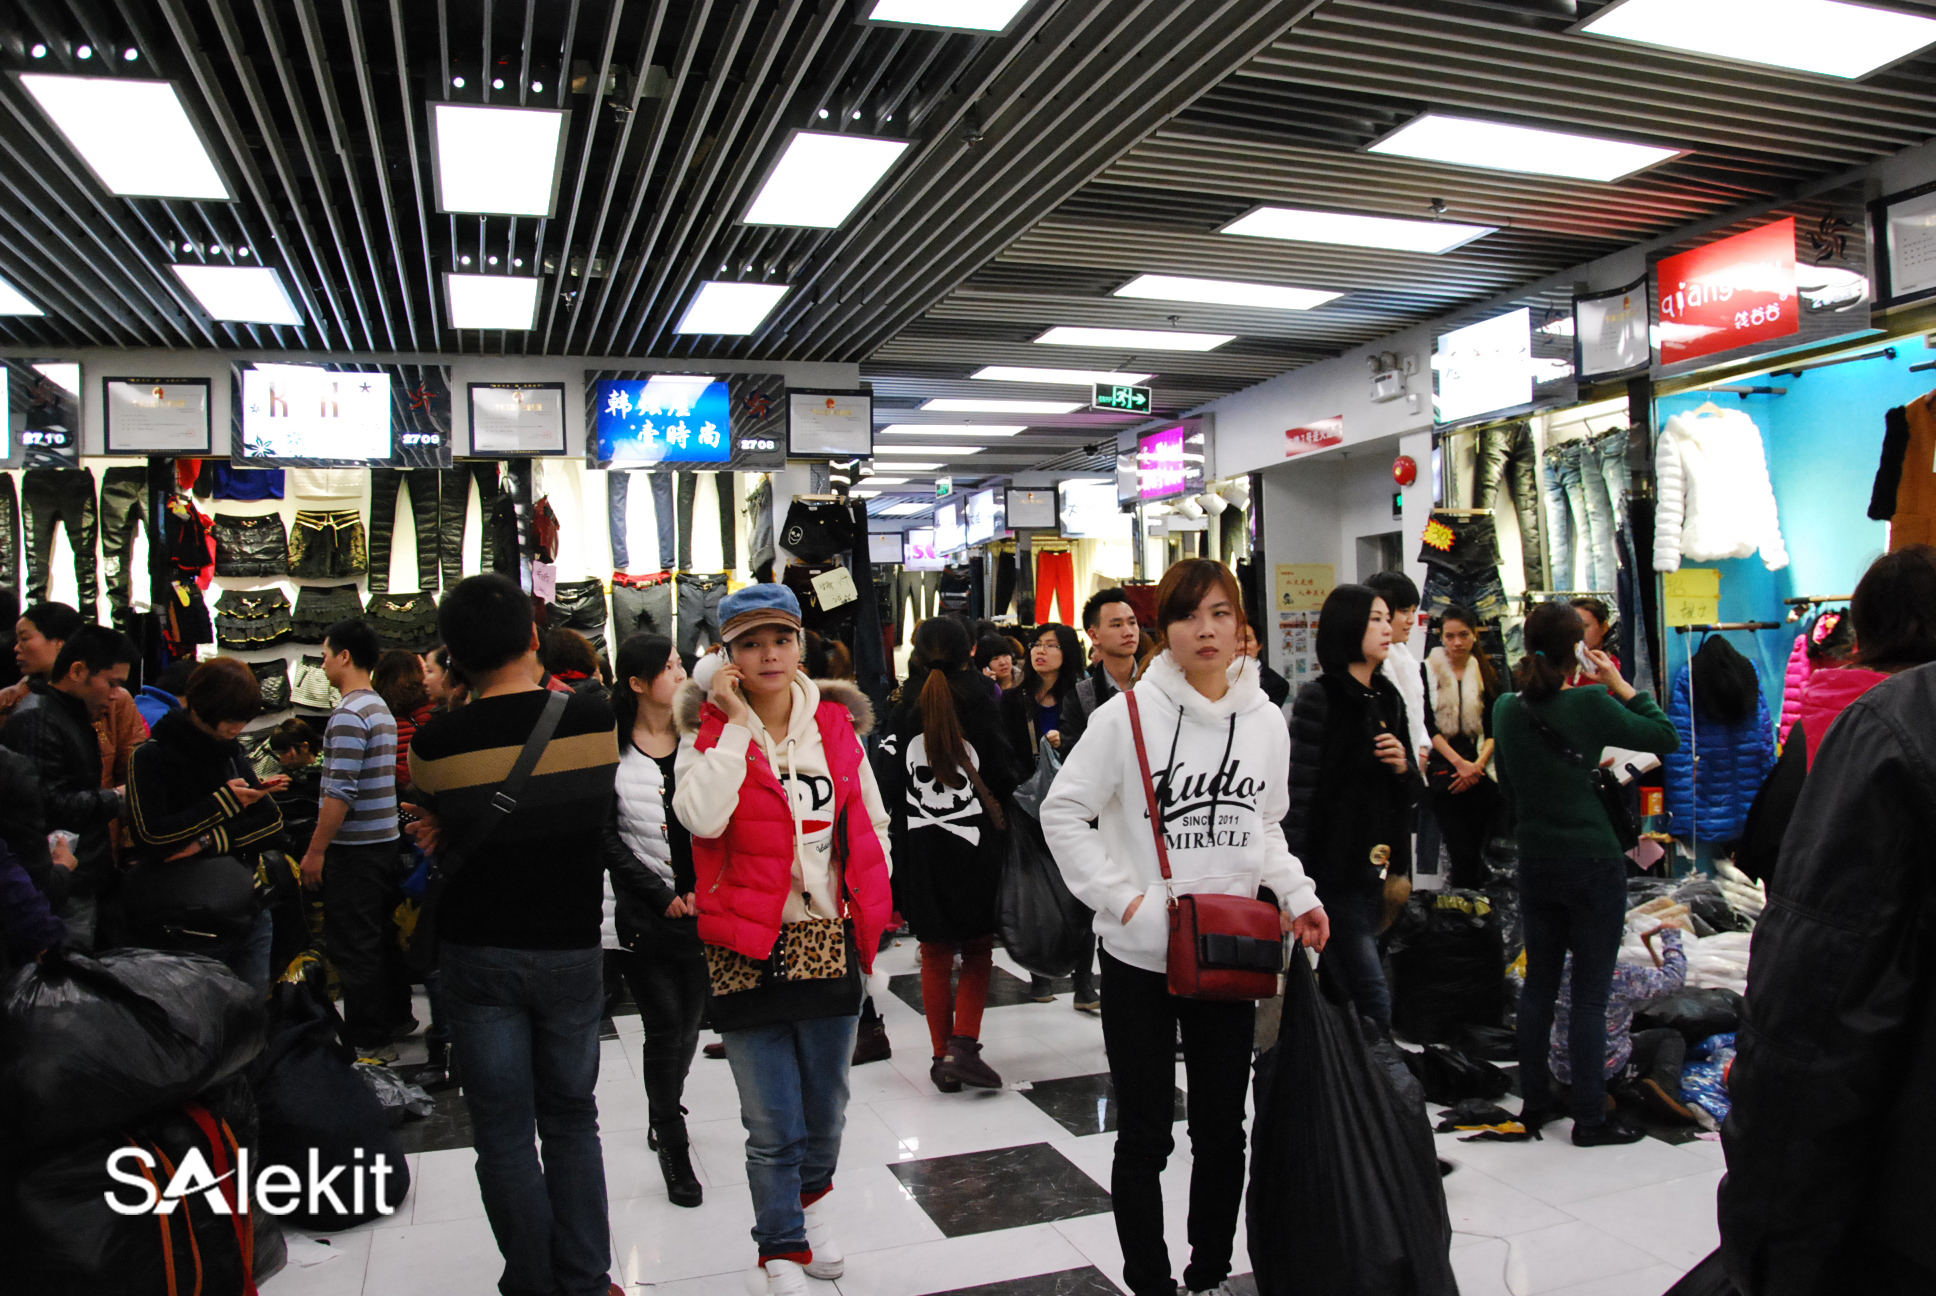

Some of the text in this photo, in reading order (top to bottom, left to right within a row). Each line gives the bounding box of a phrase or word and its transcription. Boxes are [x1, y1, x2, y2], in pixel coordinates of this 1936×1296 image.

[22, 431, 66, 445] 2710
[402, 434, 440, 444] 2709
[740, 439, 775, 450] 2708
[1218, 815, 1240, 825] 2011
[1166, 831, 1250, 851] MIRACLE
